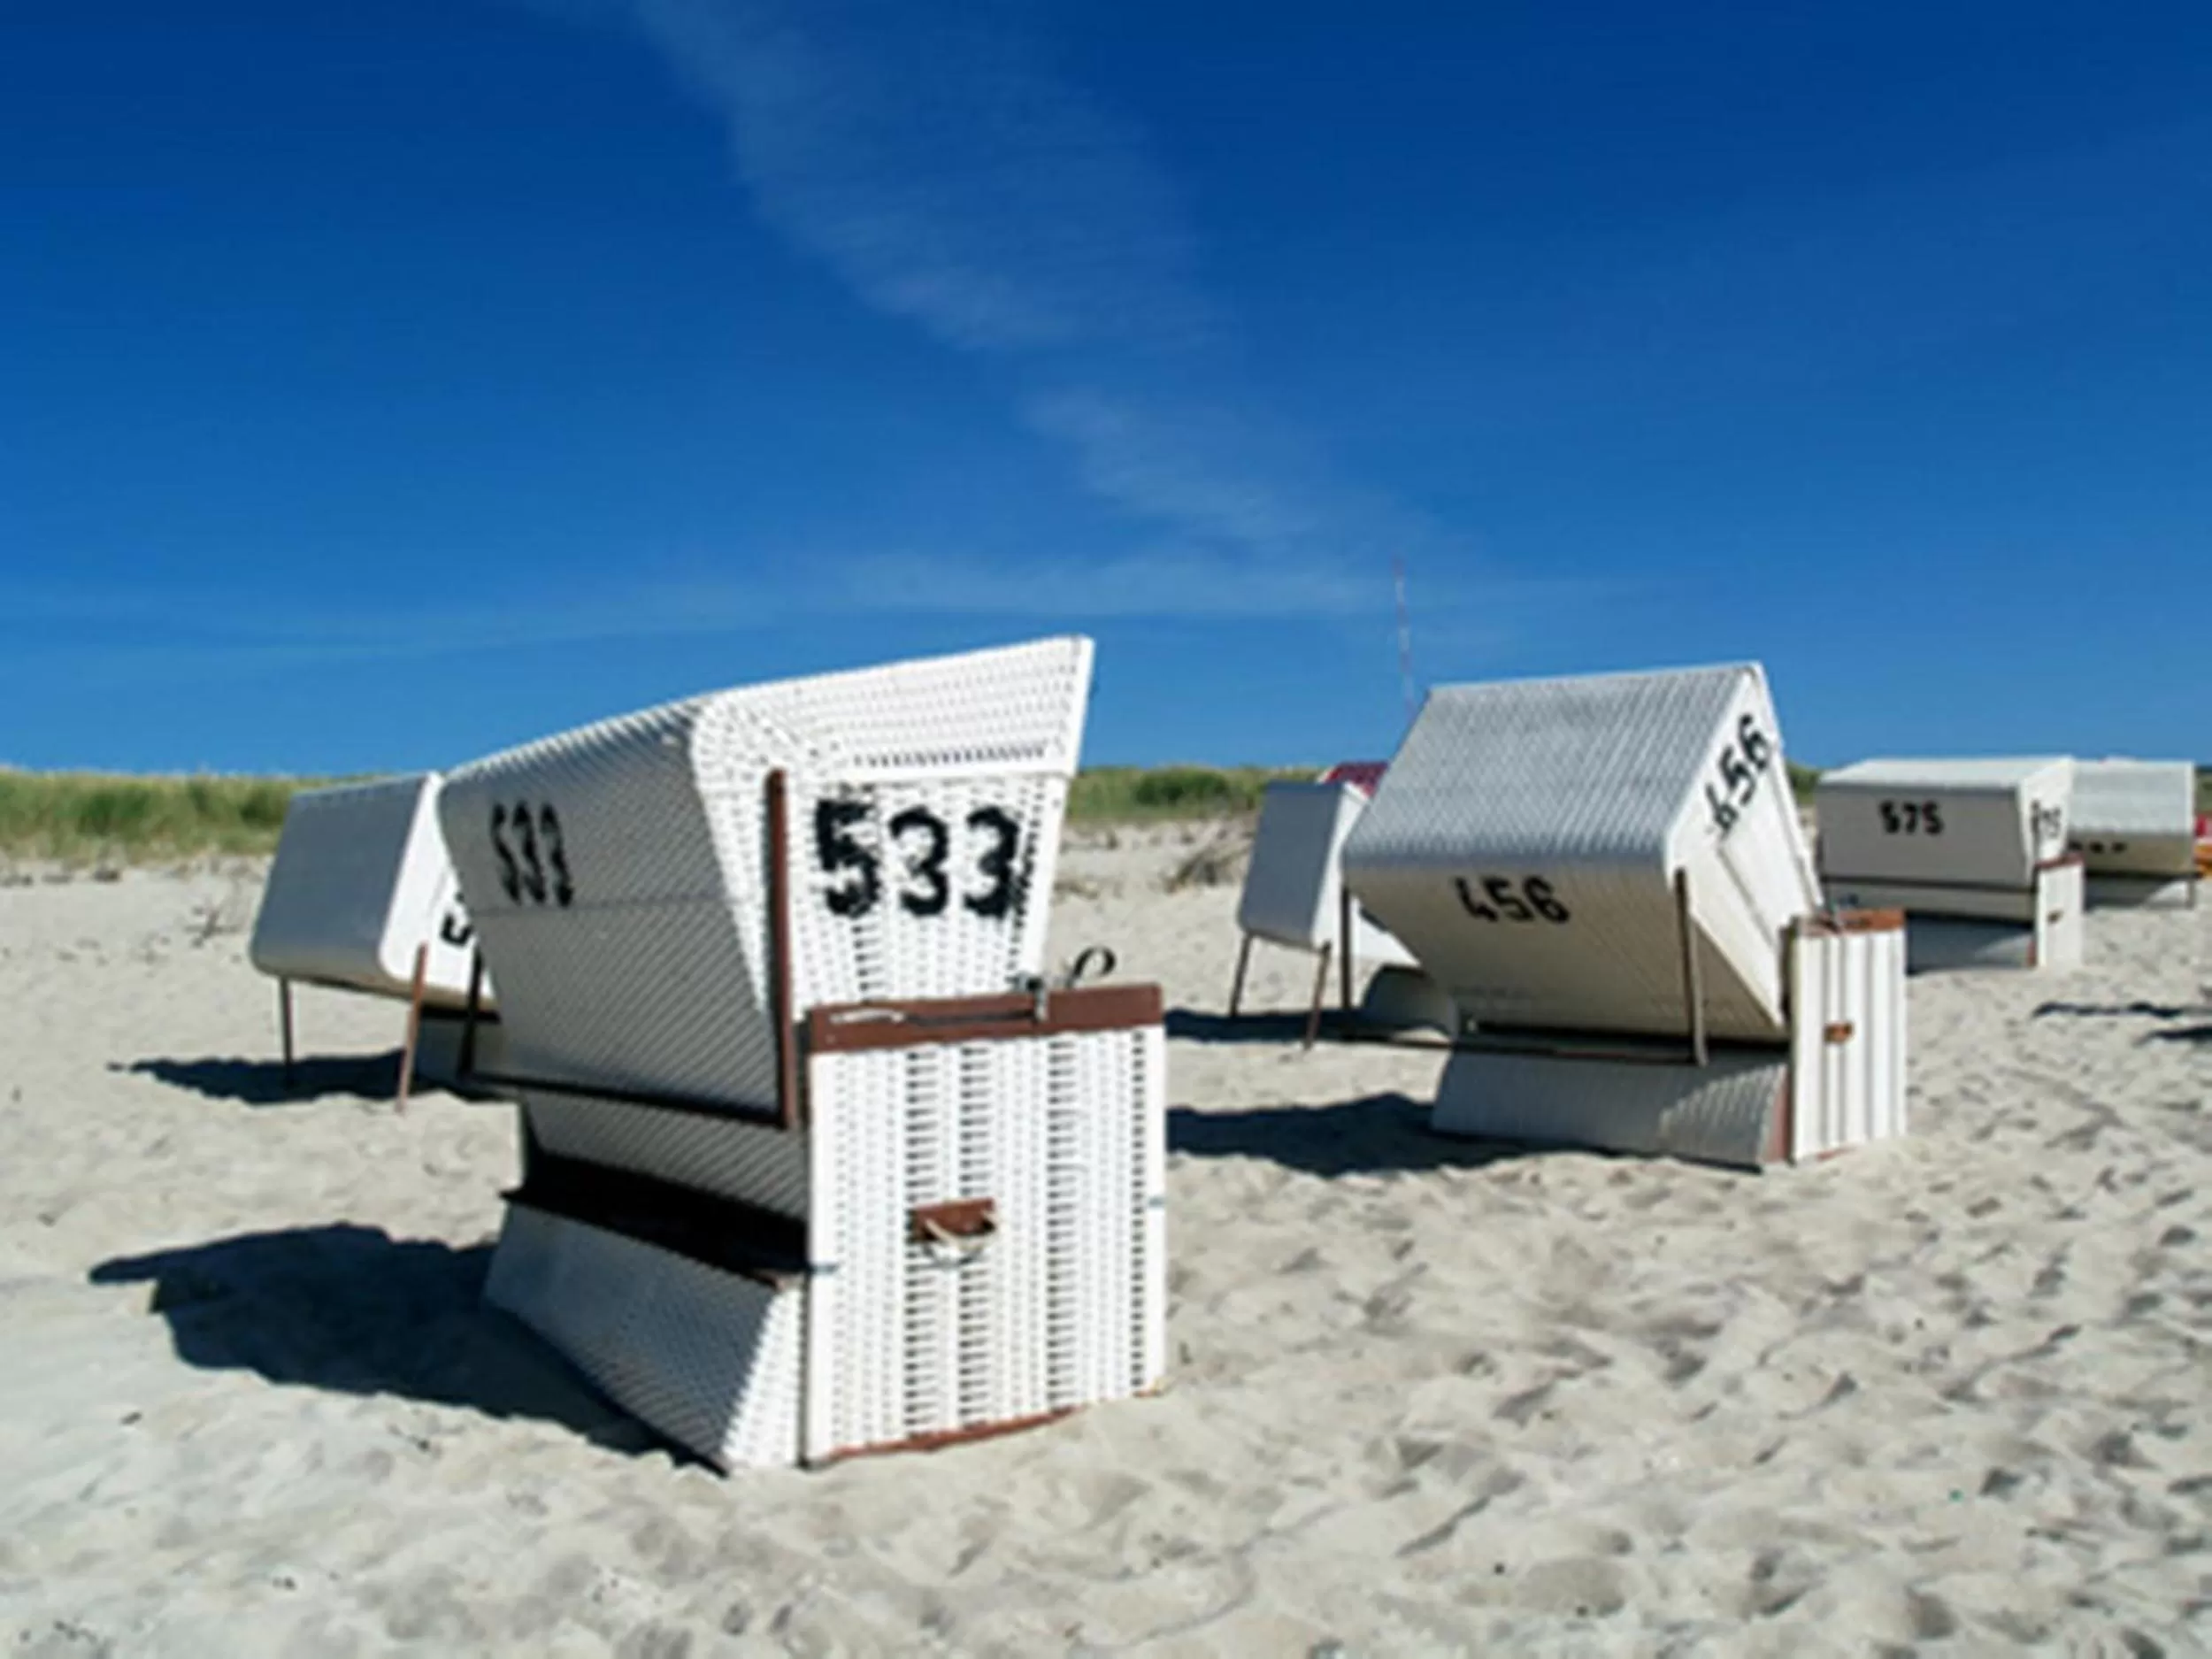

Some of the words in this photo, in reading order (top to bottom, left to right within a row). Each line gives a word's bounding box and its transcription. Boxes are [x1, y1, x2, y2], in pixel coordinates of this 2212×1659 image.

[1705, 713, 1770, 838] 456
[1878, 799, 1946, 837] 575
[491, 800, 574, 908] 533
[815, 798, 1025, 918] 533
[1454, 875, 1571, 923] 456
